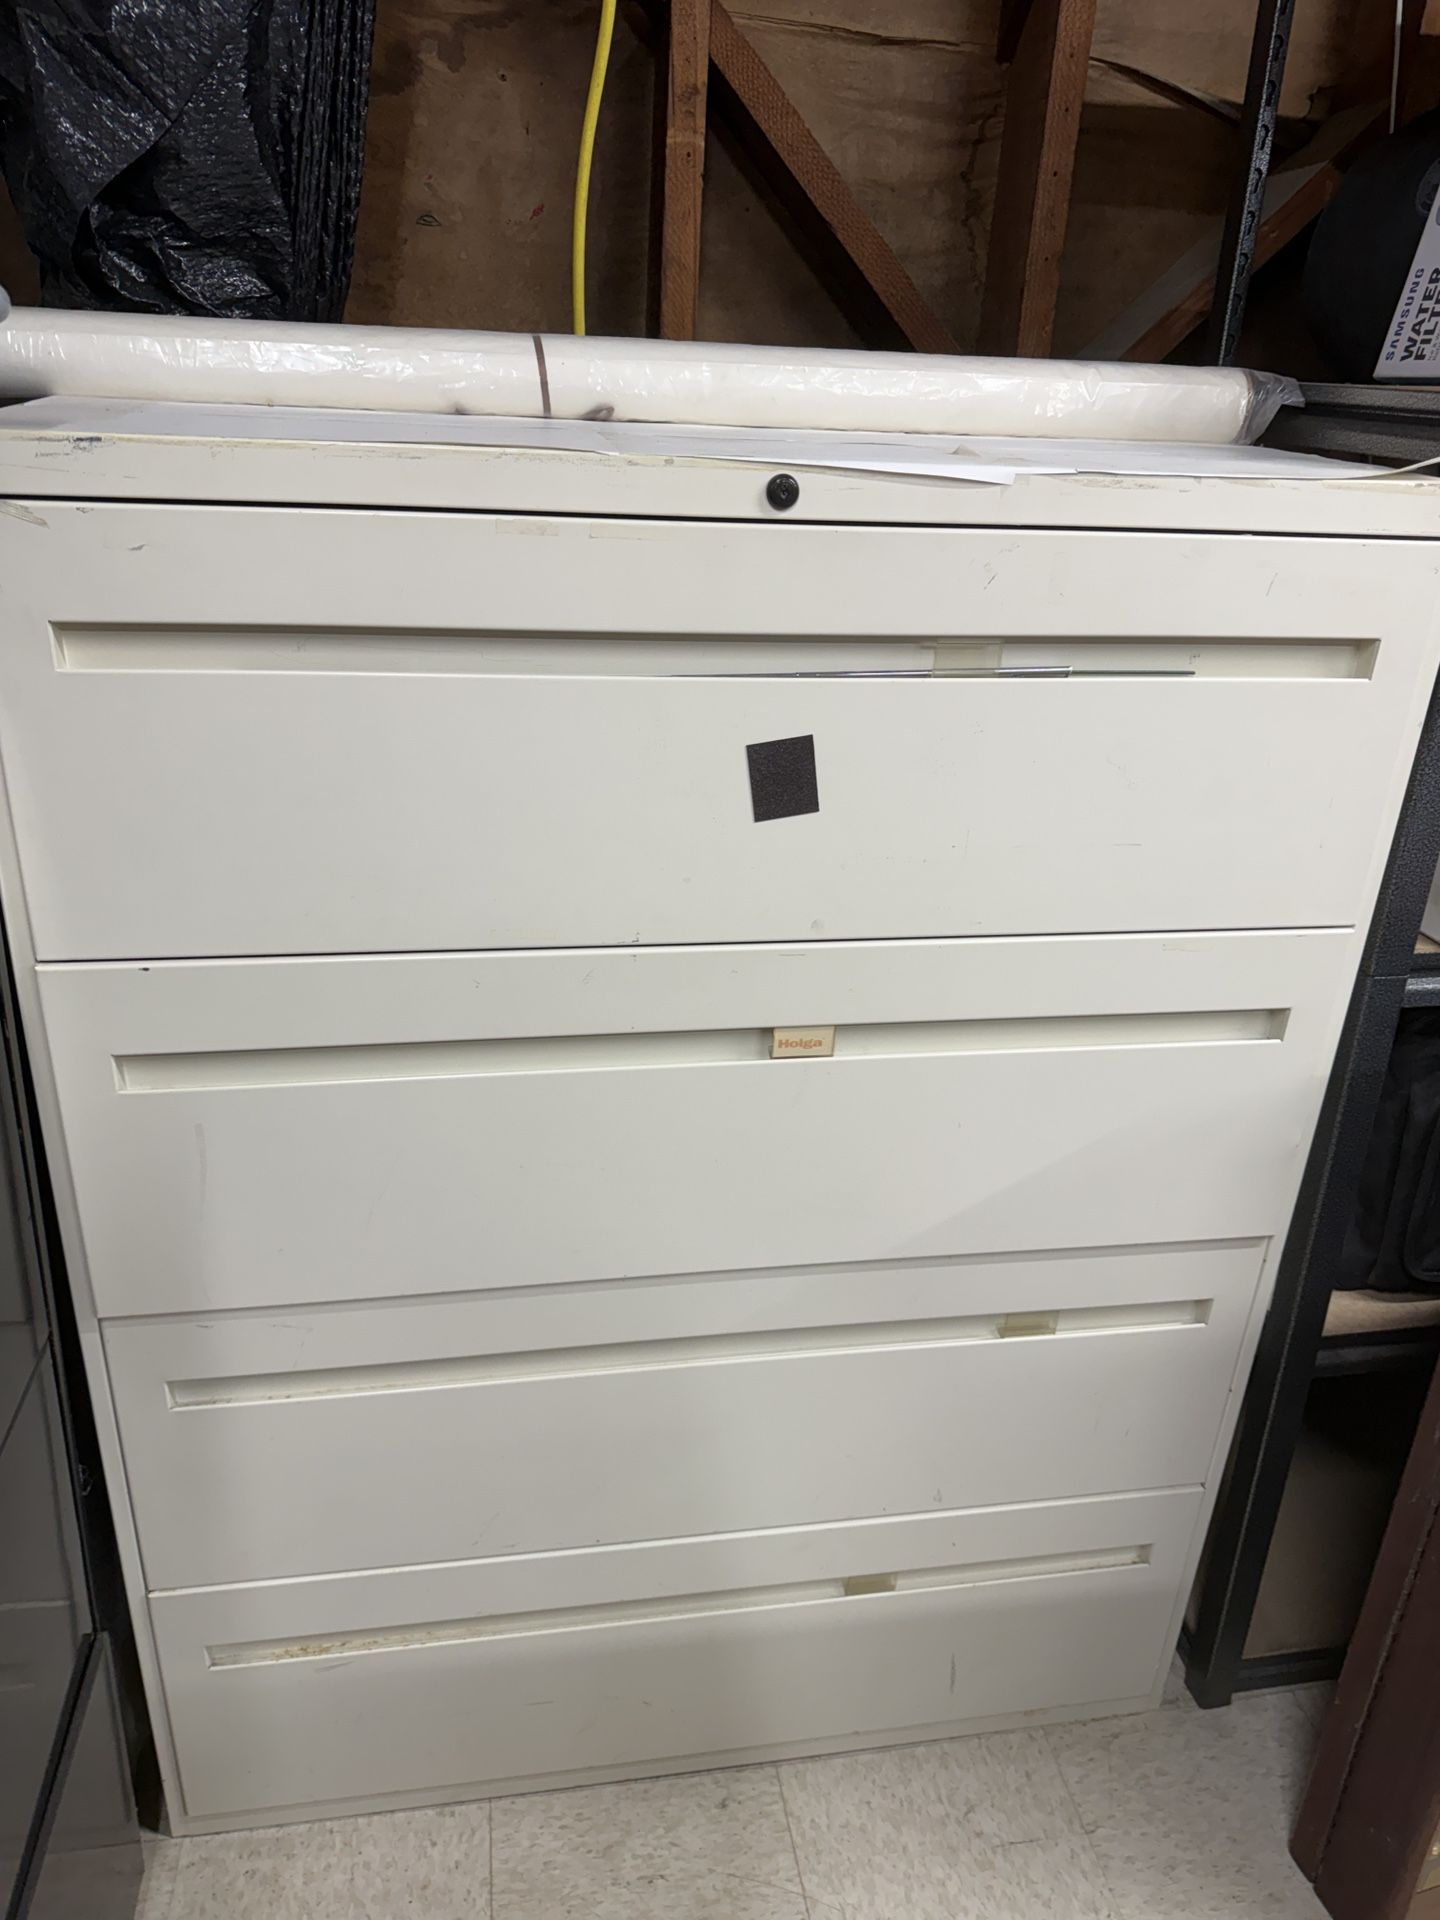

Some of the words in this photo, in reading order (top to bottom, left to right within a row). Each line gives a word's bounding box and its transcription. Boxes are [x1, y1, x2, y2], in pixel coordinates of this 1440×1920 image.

[1385, 268, 1424, 361] SAMSUNG
[1400, 267, 1440, 362] WATER
[778, 1038, 823, 1050] Holga
